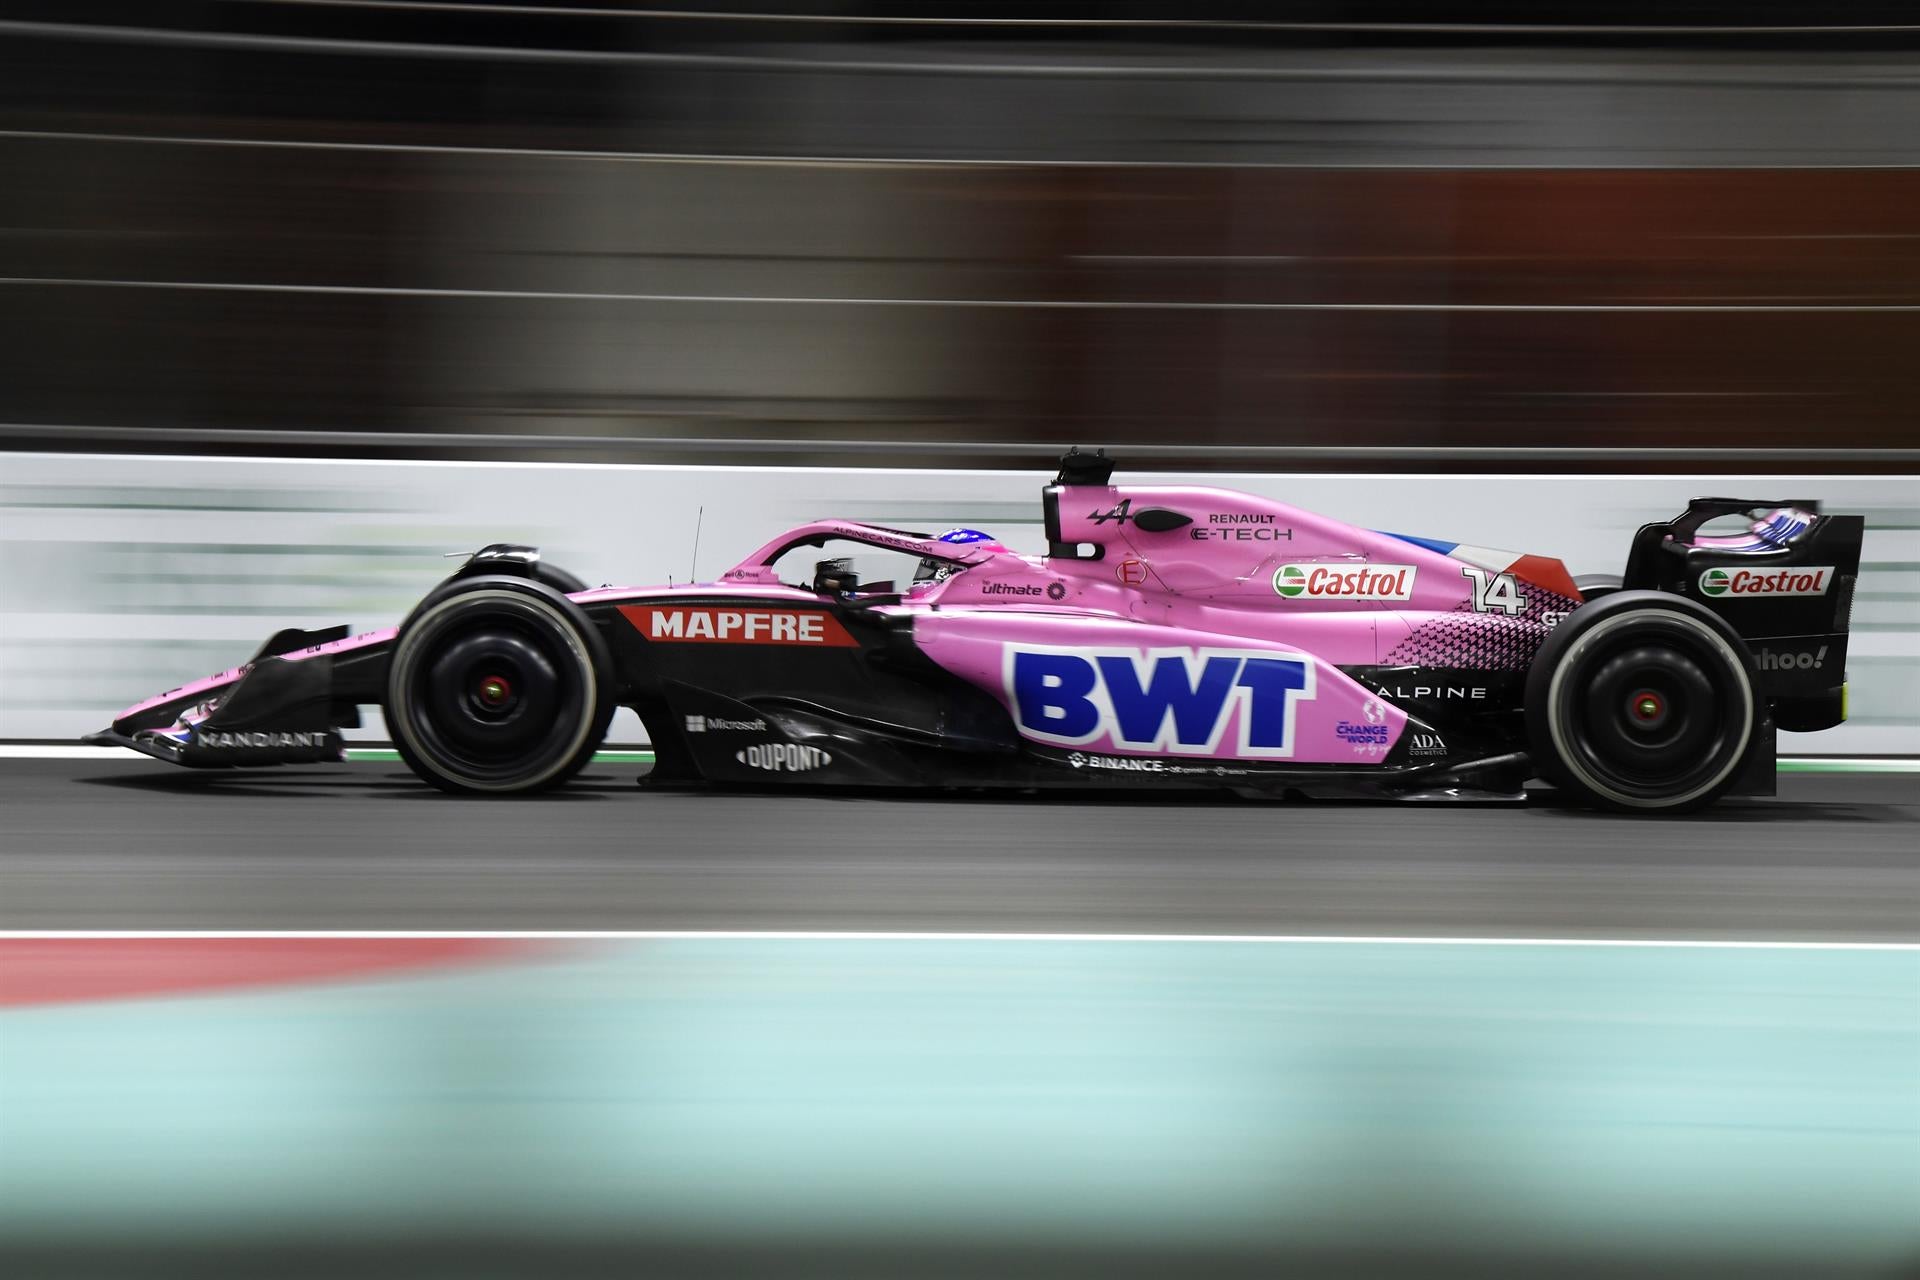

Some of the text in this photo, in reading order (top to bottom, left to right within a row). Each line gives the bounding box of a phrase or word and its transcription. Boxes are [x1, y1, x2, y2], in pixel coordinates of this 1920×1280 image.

[1209, 514, 1276, 524] RENAULT
[833, 526, 933, 553] ALPINECARS.COM
[1191, 528, 1292, 541] E-TECH
[982, 583, 1042, 596] ultimate
[1307, 568, 1406, 596] Castrol
[1731, 570, 1824, 593] Castrol
[1462, 567, 1527, 617] 14
[651, 611, 824, 642] MAPFRE
[1752, 645, 1829, 671] hoo!
[1009, 648, 1309, 751] BWT
[1377, 686, 1487, 699] ALPINE
[707, 718, 768, 731] Microsoft
[1336, 725, 1388, 735] CHANGE
[198, 732, 328, 748] MANDIANT
[1347, 735, 1388, 744] WORLD
[1410, 734, 1446, 748] ADA
[747, 743, 822, 772] DUPONT
[1089, 756, 1164, 772] BINANCE
